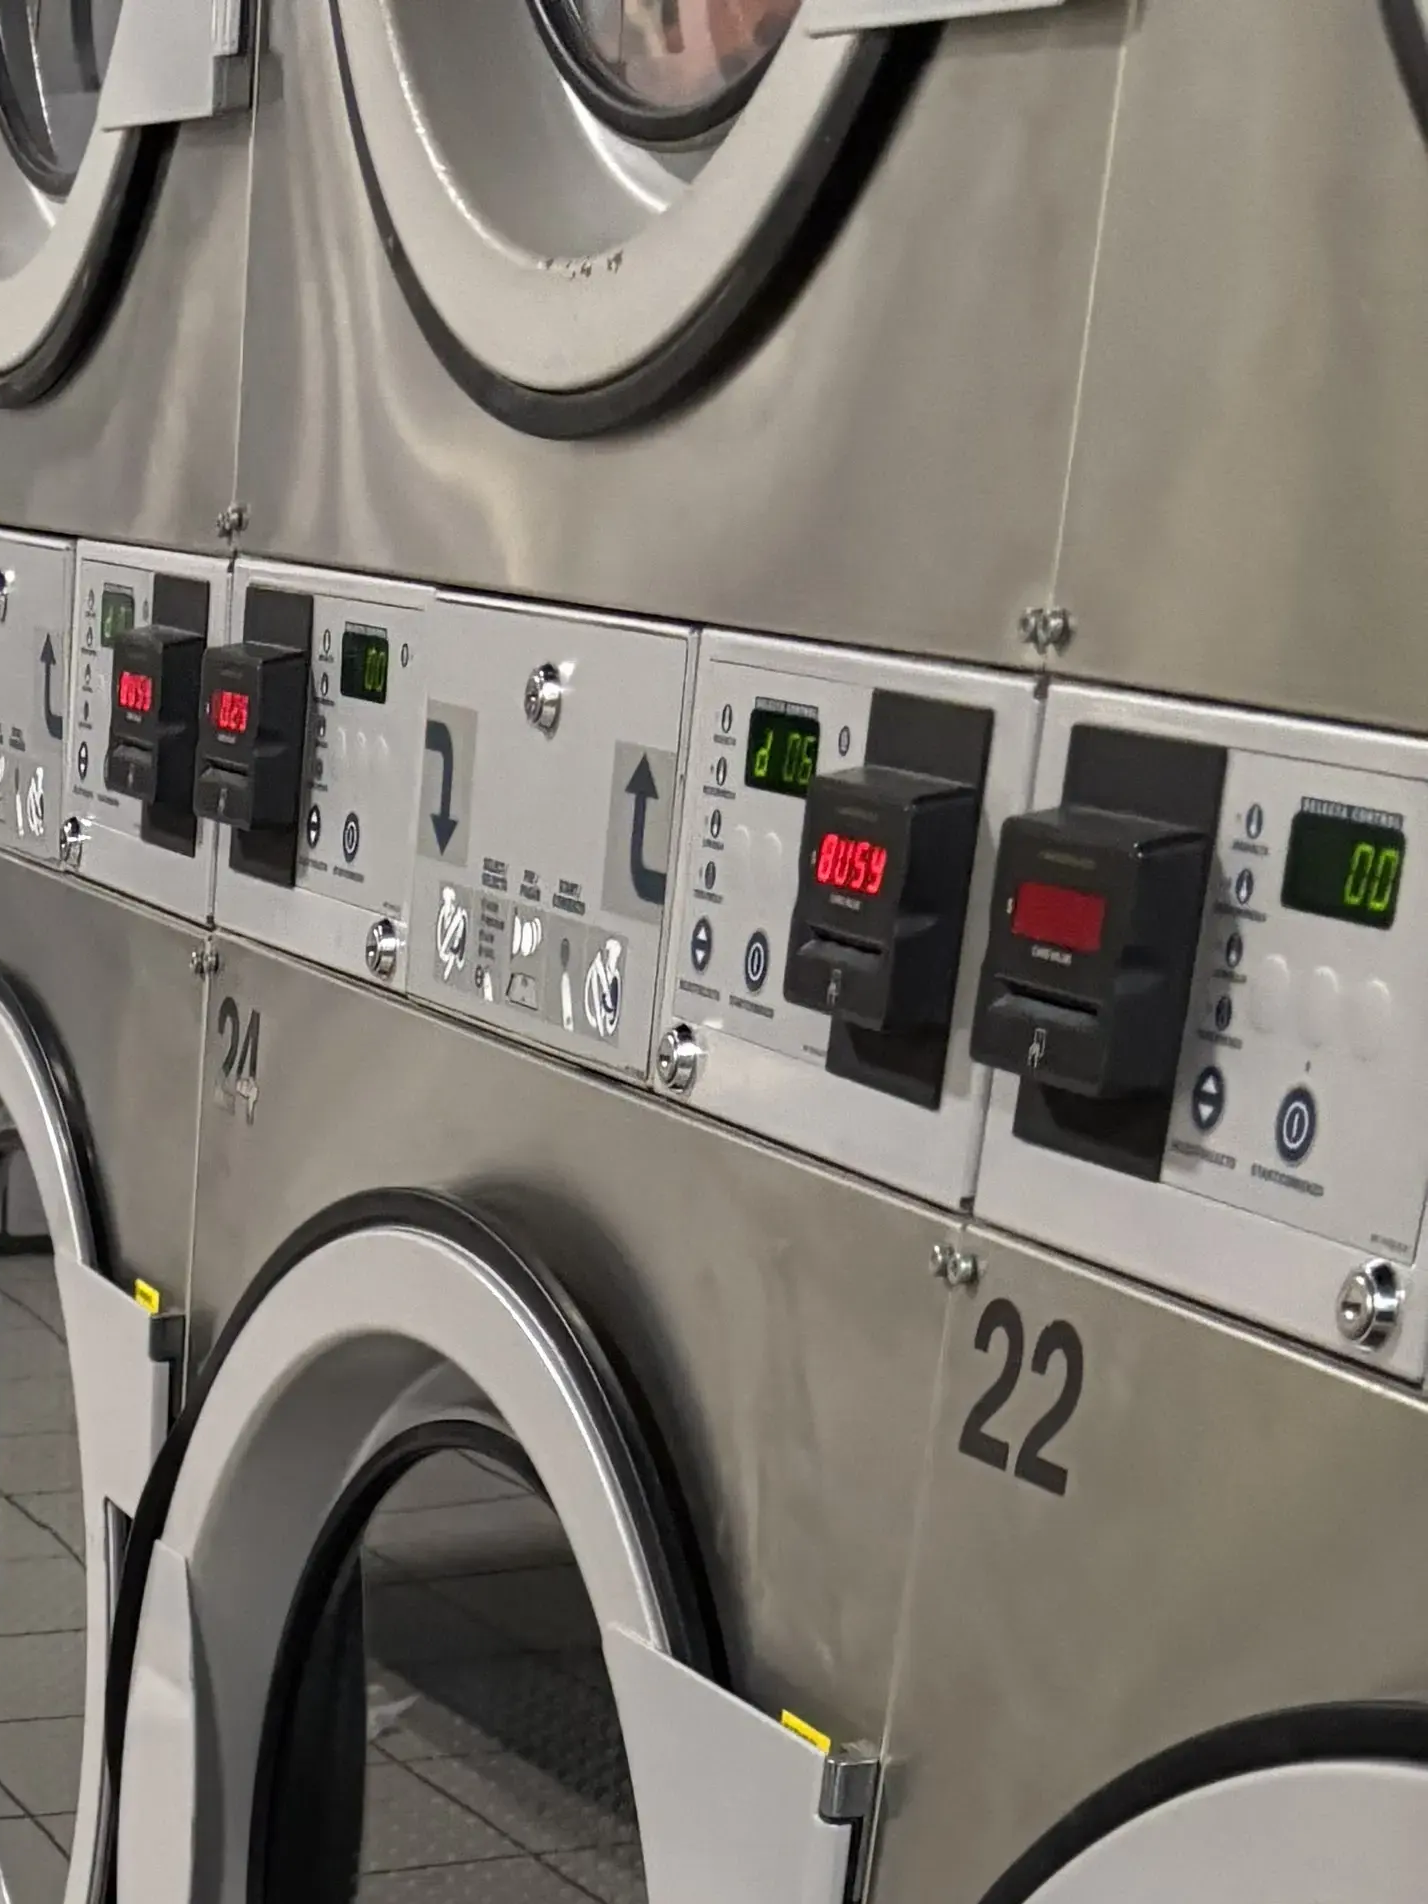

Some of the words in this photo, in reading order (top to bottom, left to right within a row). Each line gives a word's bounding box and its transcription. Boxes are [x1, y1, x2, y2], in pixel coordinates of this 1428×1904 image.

[817, 833, 888, 894] BUSY
[1344, 842, 1400, 911] 00
[958, 1297, 1084, 1497] 22
